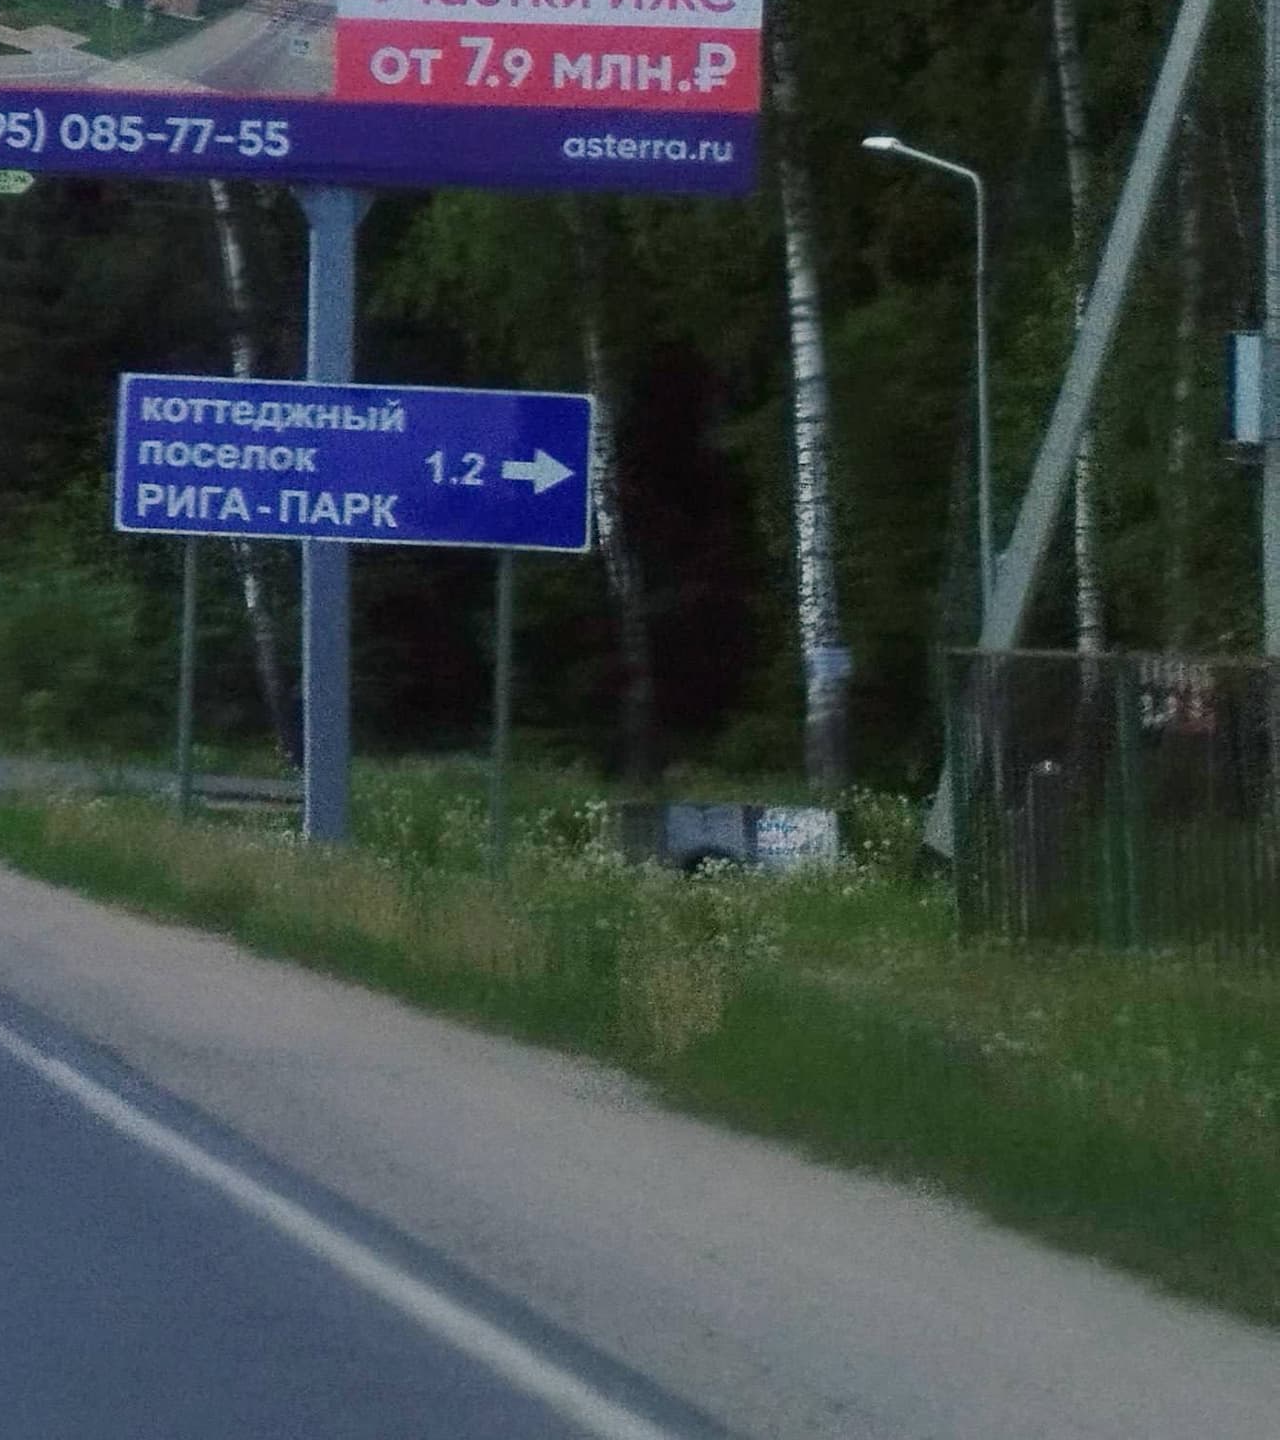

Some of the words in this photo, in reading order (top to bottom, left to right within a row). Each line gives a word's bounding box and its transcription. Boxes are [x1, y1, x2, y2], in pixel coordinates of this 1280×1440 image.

[370, 46, 442, 86] от
[460, 36, 534, 88] 7.9
[59, 113, 290, 158] 085-77-55
[562, 133, 734, 162] asterra.ru
[141, 396, 407, 434] коттеджный
[139, 439, 318, 473] поселок
[425, 450, 485, 486] 1.2
